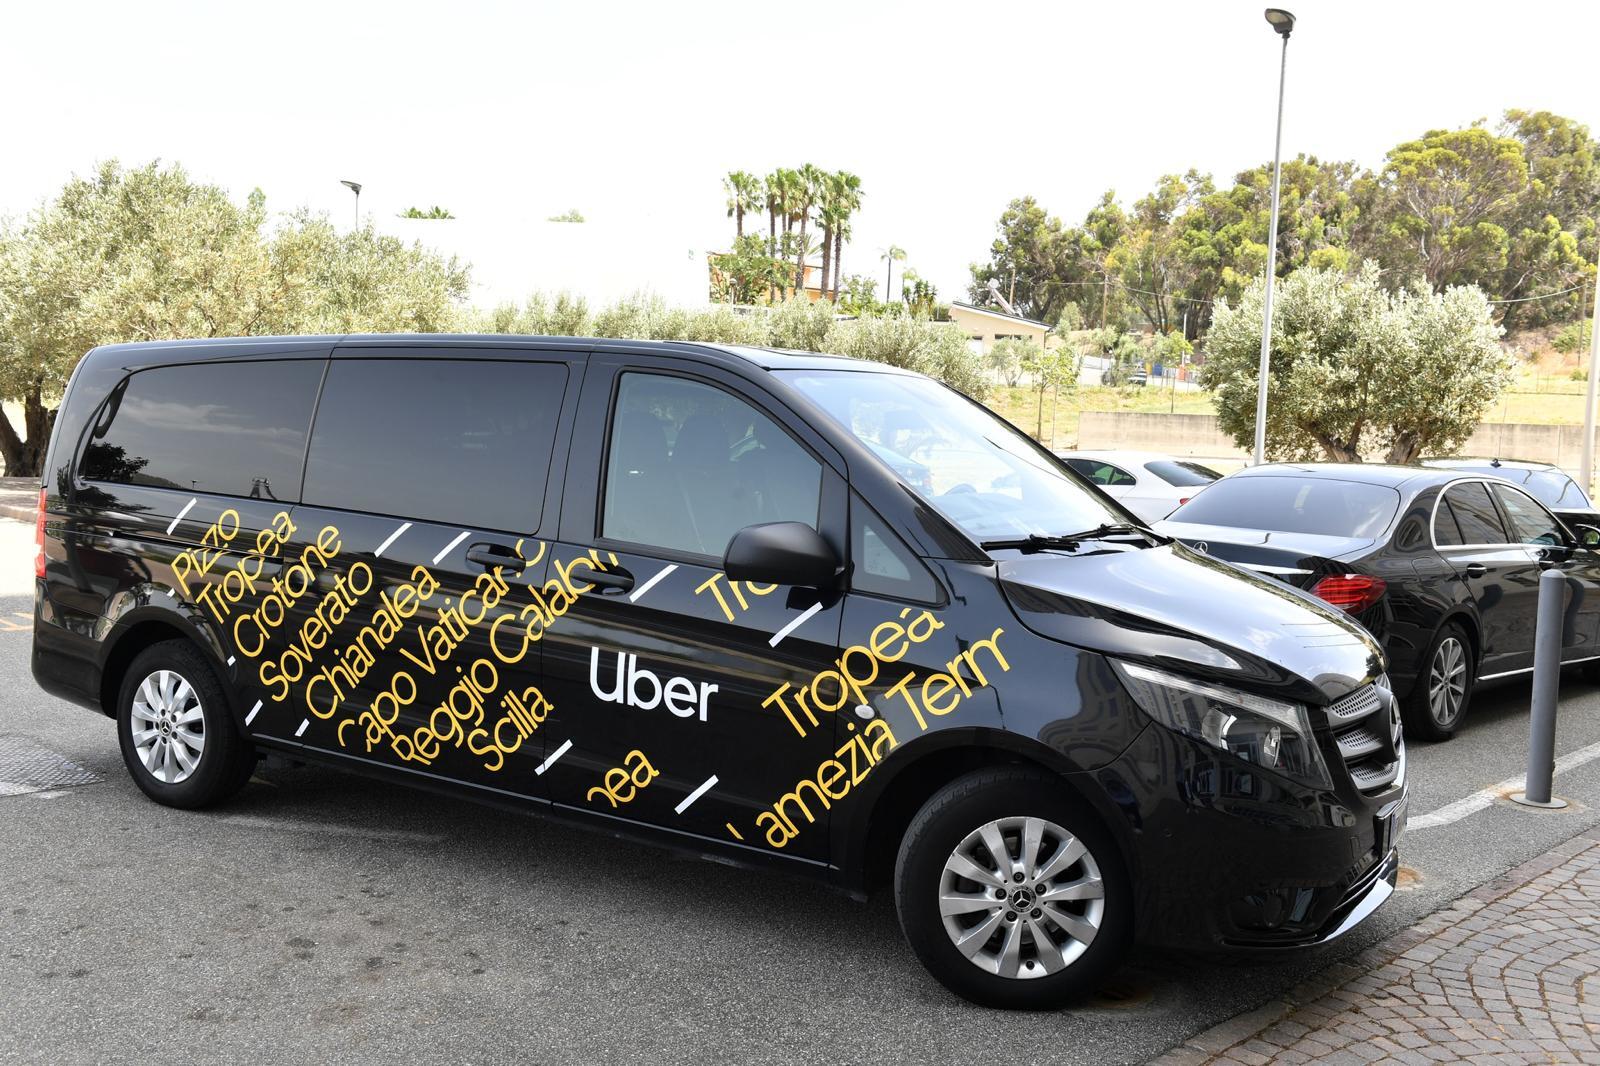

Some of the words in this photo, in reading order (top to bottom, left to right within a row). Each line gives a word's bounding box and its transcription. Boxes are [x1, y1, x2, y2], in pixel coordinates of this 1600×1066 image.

[170, 508, 240, 597] Pizzo
[194, 510, 298, 625] Tropea
[233, 525, 343, 658] Crotone
[259, 561, 373, 702] Soverato
[305, 565, 441, 720] Chianalea
[589, 645, 719, 722] Uber
[760, 607, 946, 738] Tropea
[390, 658, 499, 766] Reggio
[467, 685, 555, 772] Scilla
[725, 718, 901, 849] amezia
